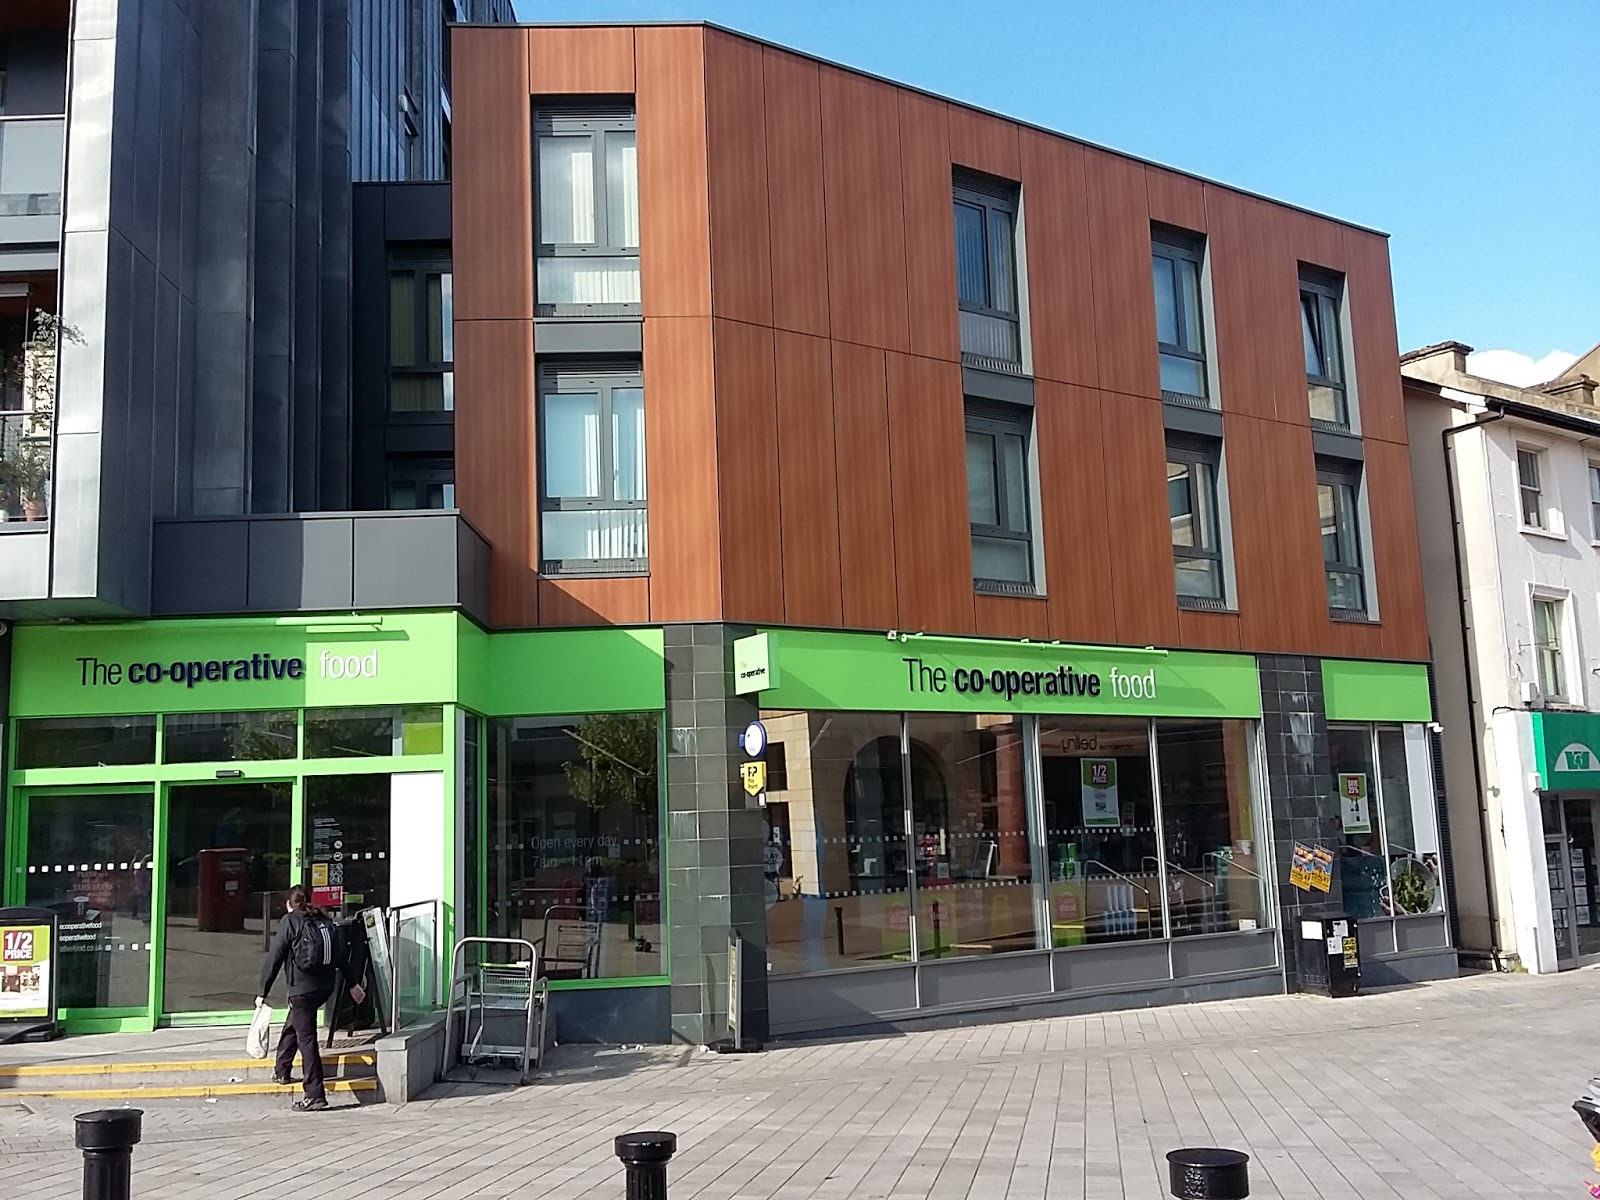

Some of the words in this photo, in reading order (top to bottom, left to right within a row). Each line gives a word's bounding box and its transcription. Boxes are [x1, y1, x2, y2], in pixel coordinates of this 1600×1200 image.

[76, 657, 122, 686] The
[128, 653, 303, 688] co-operative
[318, 649, 378, 679] food
[740, 667, 766, 679] co-operative
[902, 658, 947, 692] The
[953, 666, 1101, 700] co-operative
[1109, 666, 1157, 699] food
[1092, 764, 1108, 777] 1/2
[531, 836, 561, 851] Open
[564, 837, 595, 850] every
[597, 834, 618, 848] day
[532, 855, 557, 869] 7am
[4, 931, 33, 950] 1/2
[4, 948, 33, 960] PRICE
